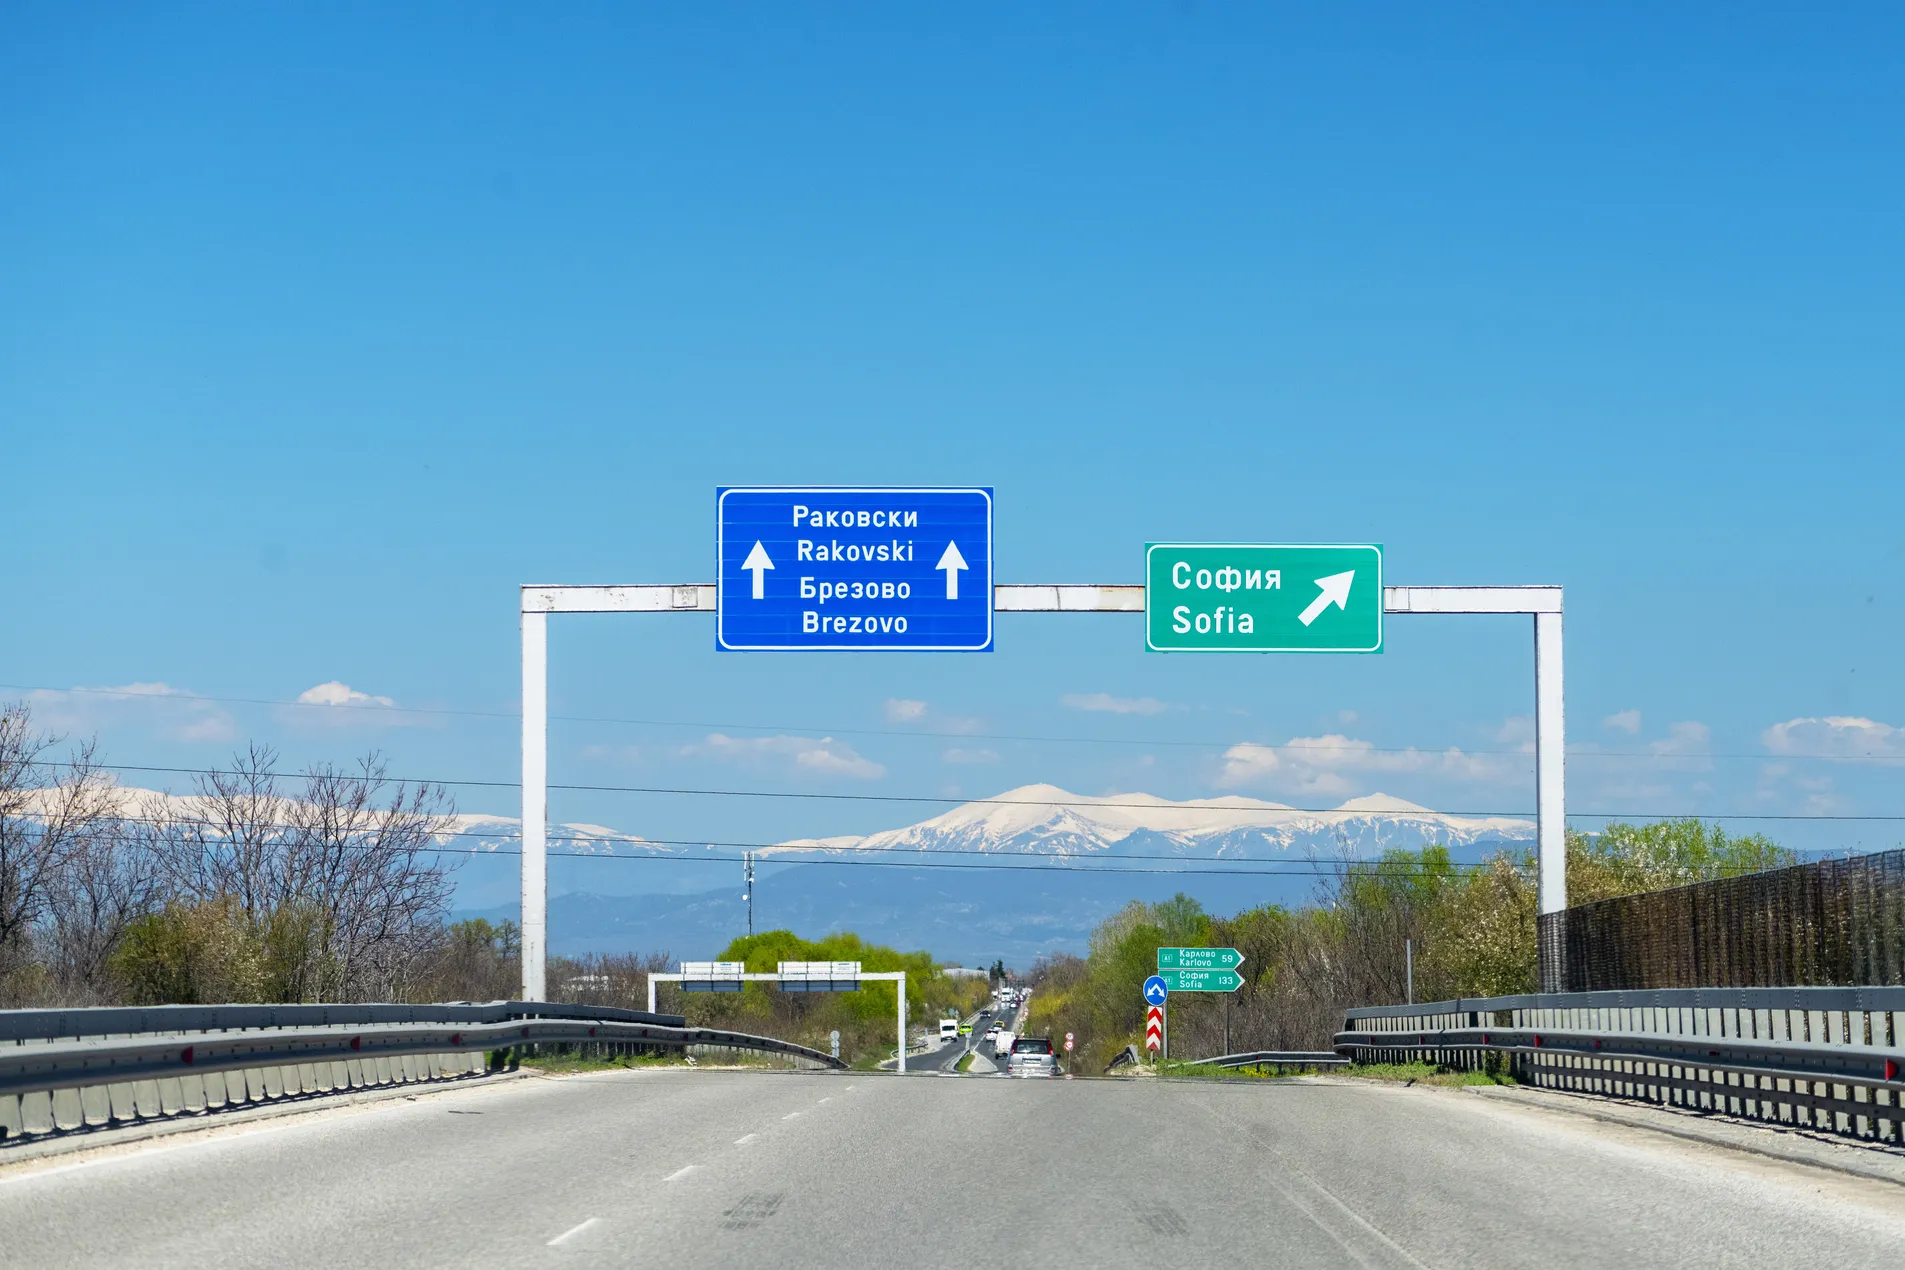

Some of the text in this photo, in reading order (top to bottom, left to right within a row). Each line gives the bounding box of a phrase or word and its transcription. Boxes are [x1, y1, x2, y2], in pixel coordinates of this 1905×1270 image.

[793, 505, 918, 528] Раковски
[797, 539, 914, 562] Rakovski
[1172, 561, 1281, 593] София
[800, 576, 911, 604] Брезово
[802, 611, 908, 633] Brezovo
[1172, 605, 1254, 634] Sofia
[1179, 949, 1216, 959] Карлово
[1221, 954, 1233, 963] 59
[1179, 958, 1212, 967] Karlovo
[1179, 970, 1209, 980] София
[1218, 976, 1233, 985] 133
[1179, 980, 1203, 989] Sofia
